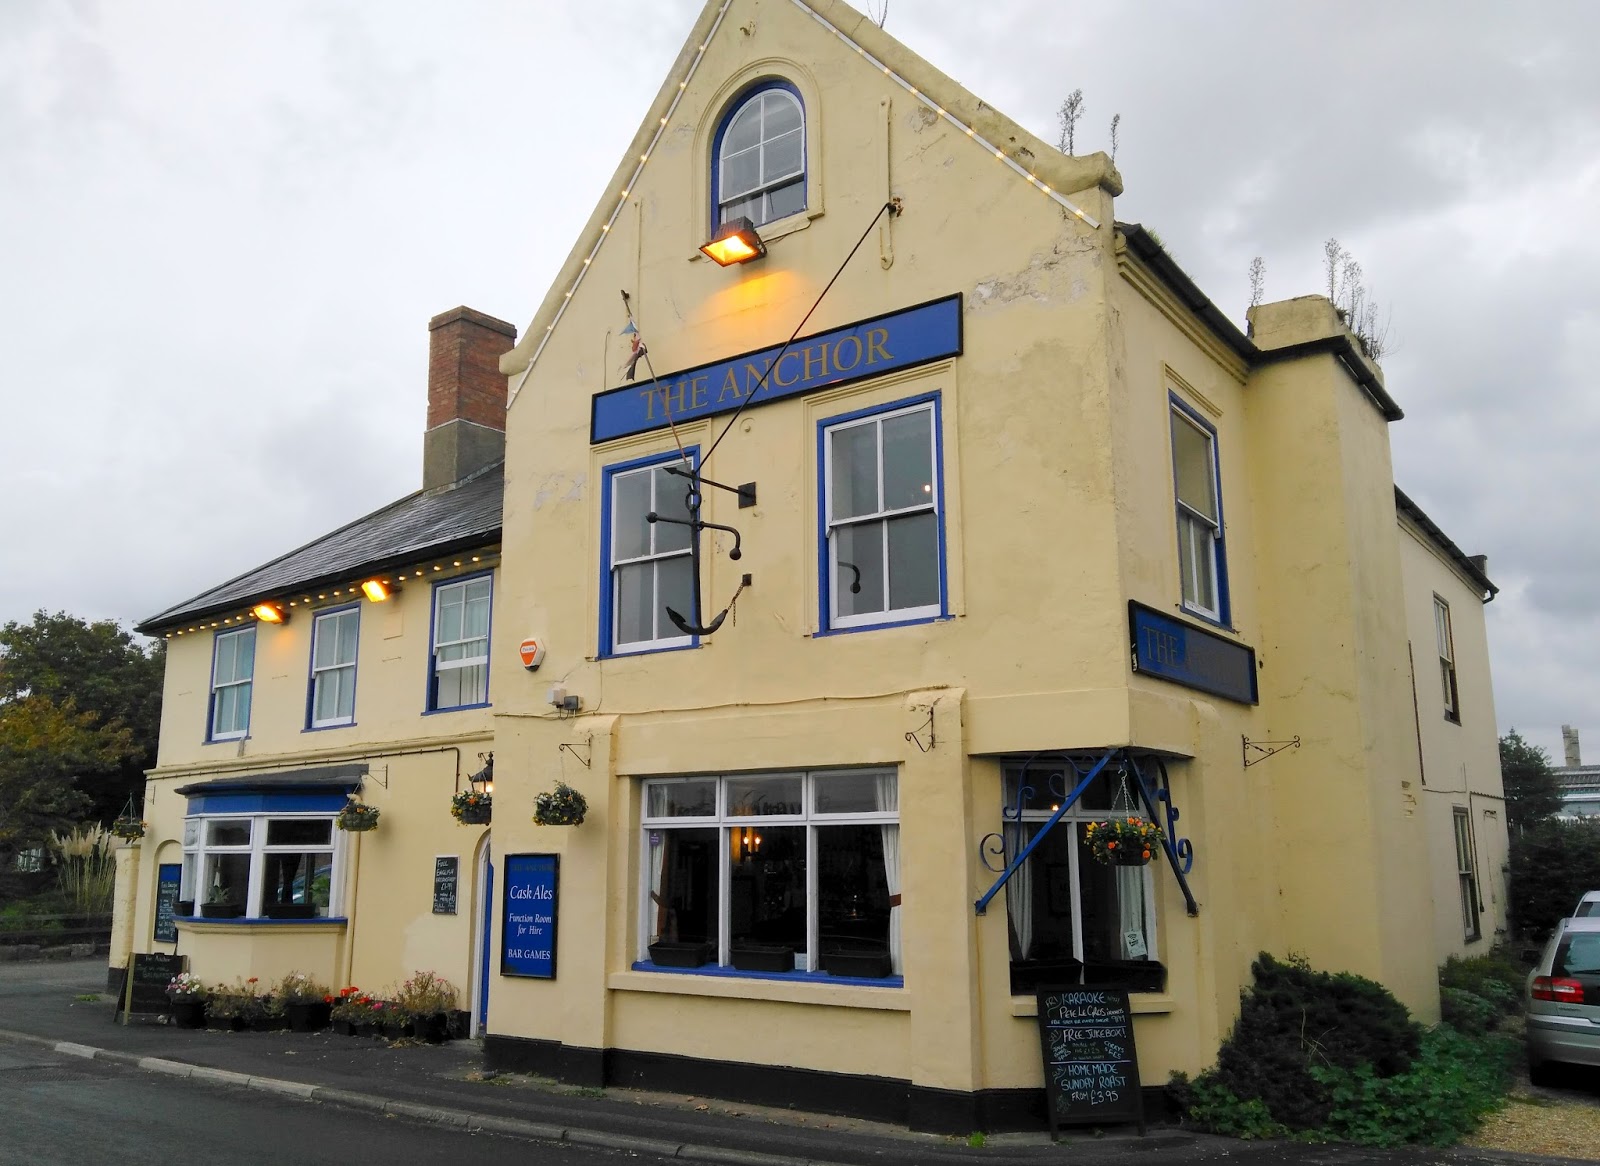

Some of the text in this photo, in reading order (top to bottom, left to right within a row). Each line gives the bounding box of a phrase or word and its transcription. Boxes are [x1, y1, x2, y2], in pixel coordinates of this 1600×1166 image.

[639, 327, 894, 422] THE ANCHOR
[1142, 626, 1180, 669] THE
[509, 884, 553, 900] Cask Ales
[508, 912, 552, 924] Function Room
[516, 924, 543, 937] for Hire
[508, 948, 551, 960] BAR GAMES
[1061, 991, 1107, 1006] KARAOKE
[1062, 1028, 1085, 1043] FREE
[1060, 1075, 1127, 1092] SUNDAY ROAST
[1071, 1090, 1089, 1102] FROM
